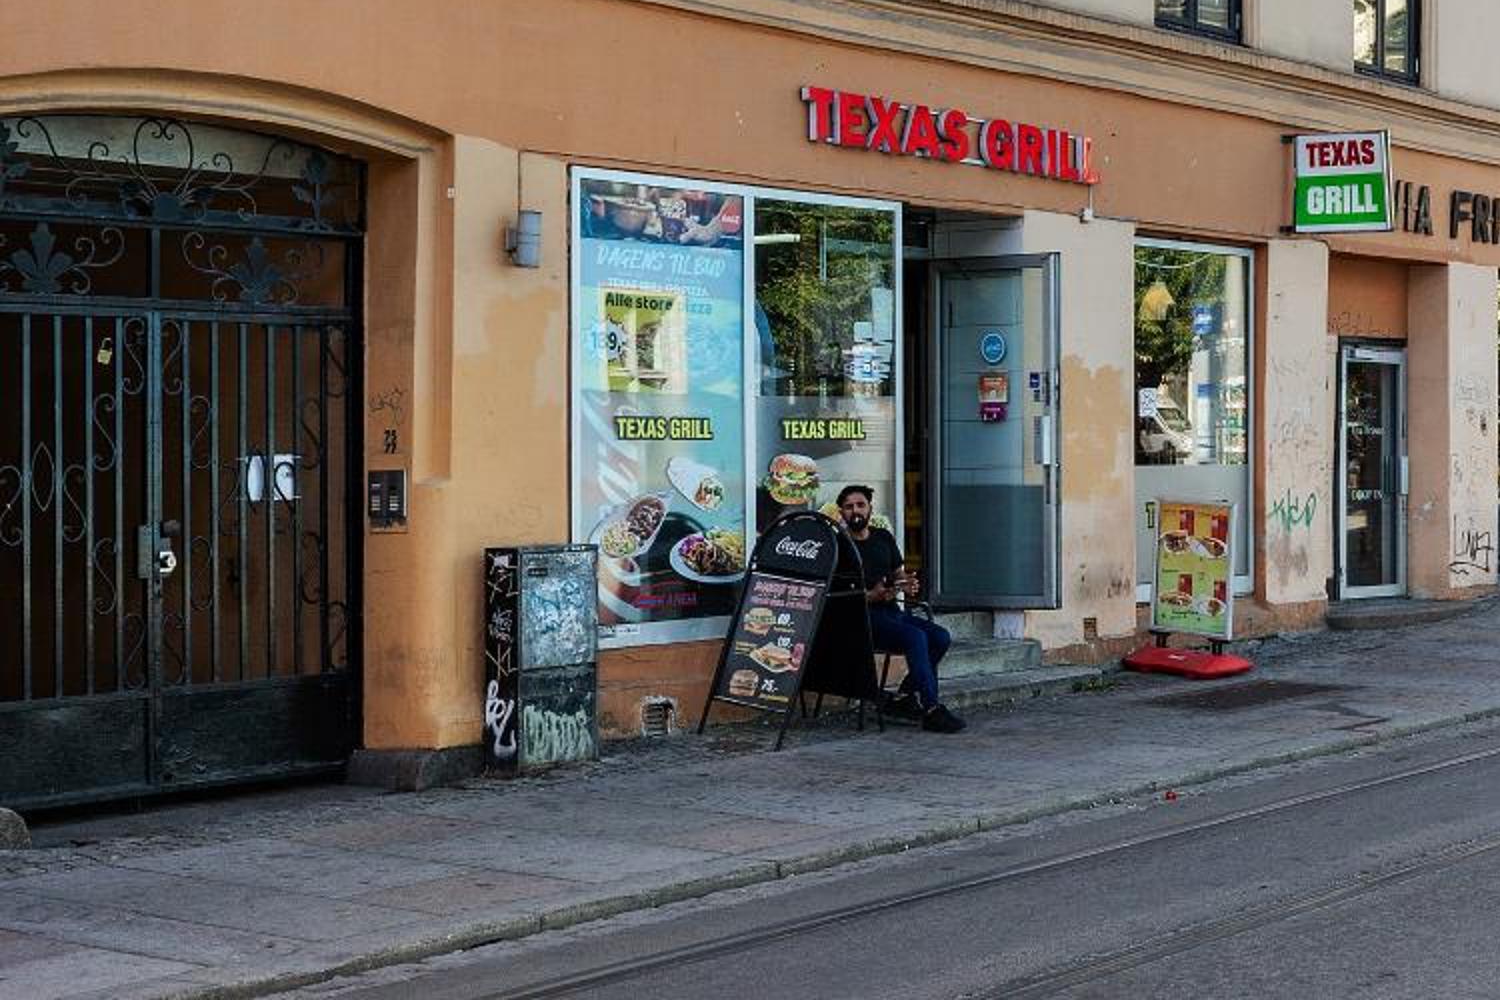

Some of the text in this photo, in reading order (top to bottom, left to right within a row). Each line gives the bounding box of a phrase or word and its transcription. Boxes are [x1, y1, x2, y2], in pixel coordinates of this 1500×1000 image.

[800, 87, 1101, 185] TEXAS GRILL
[1305, 139, 1376, 169] TEXAS
[1306, 183, 1378, 216] GRILL
[595, 246, 726, 277] DAGENS TILBUD
[605, 292, 633, 309] Alle
[634, 294, 674, 311] store
[616, 416, 714, 440] TEXAS GRILL
[782, 419, 866, 440] TEXAS GRILL
